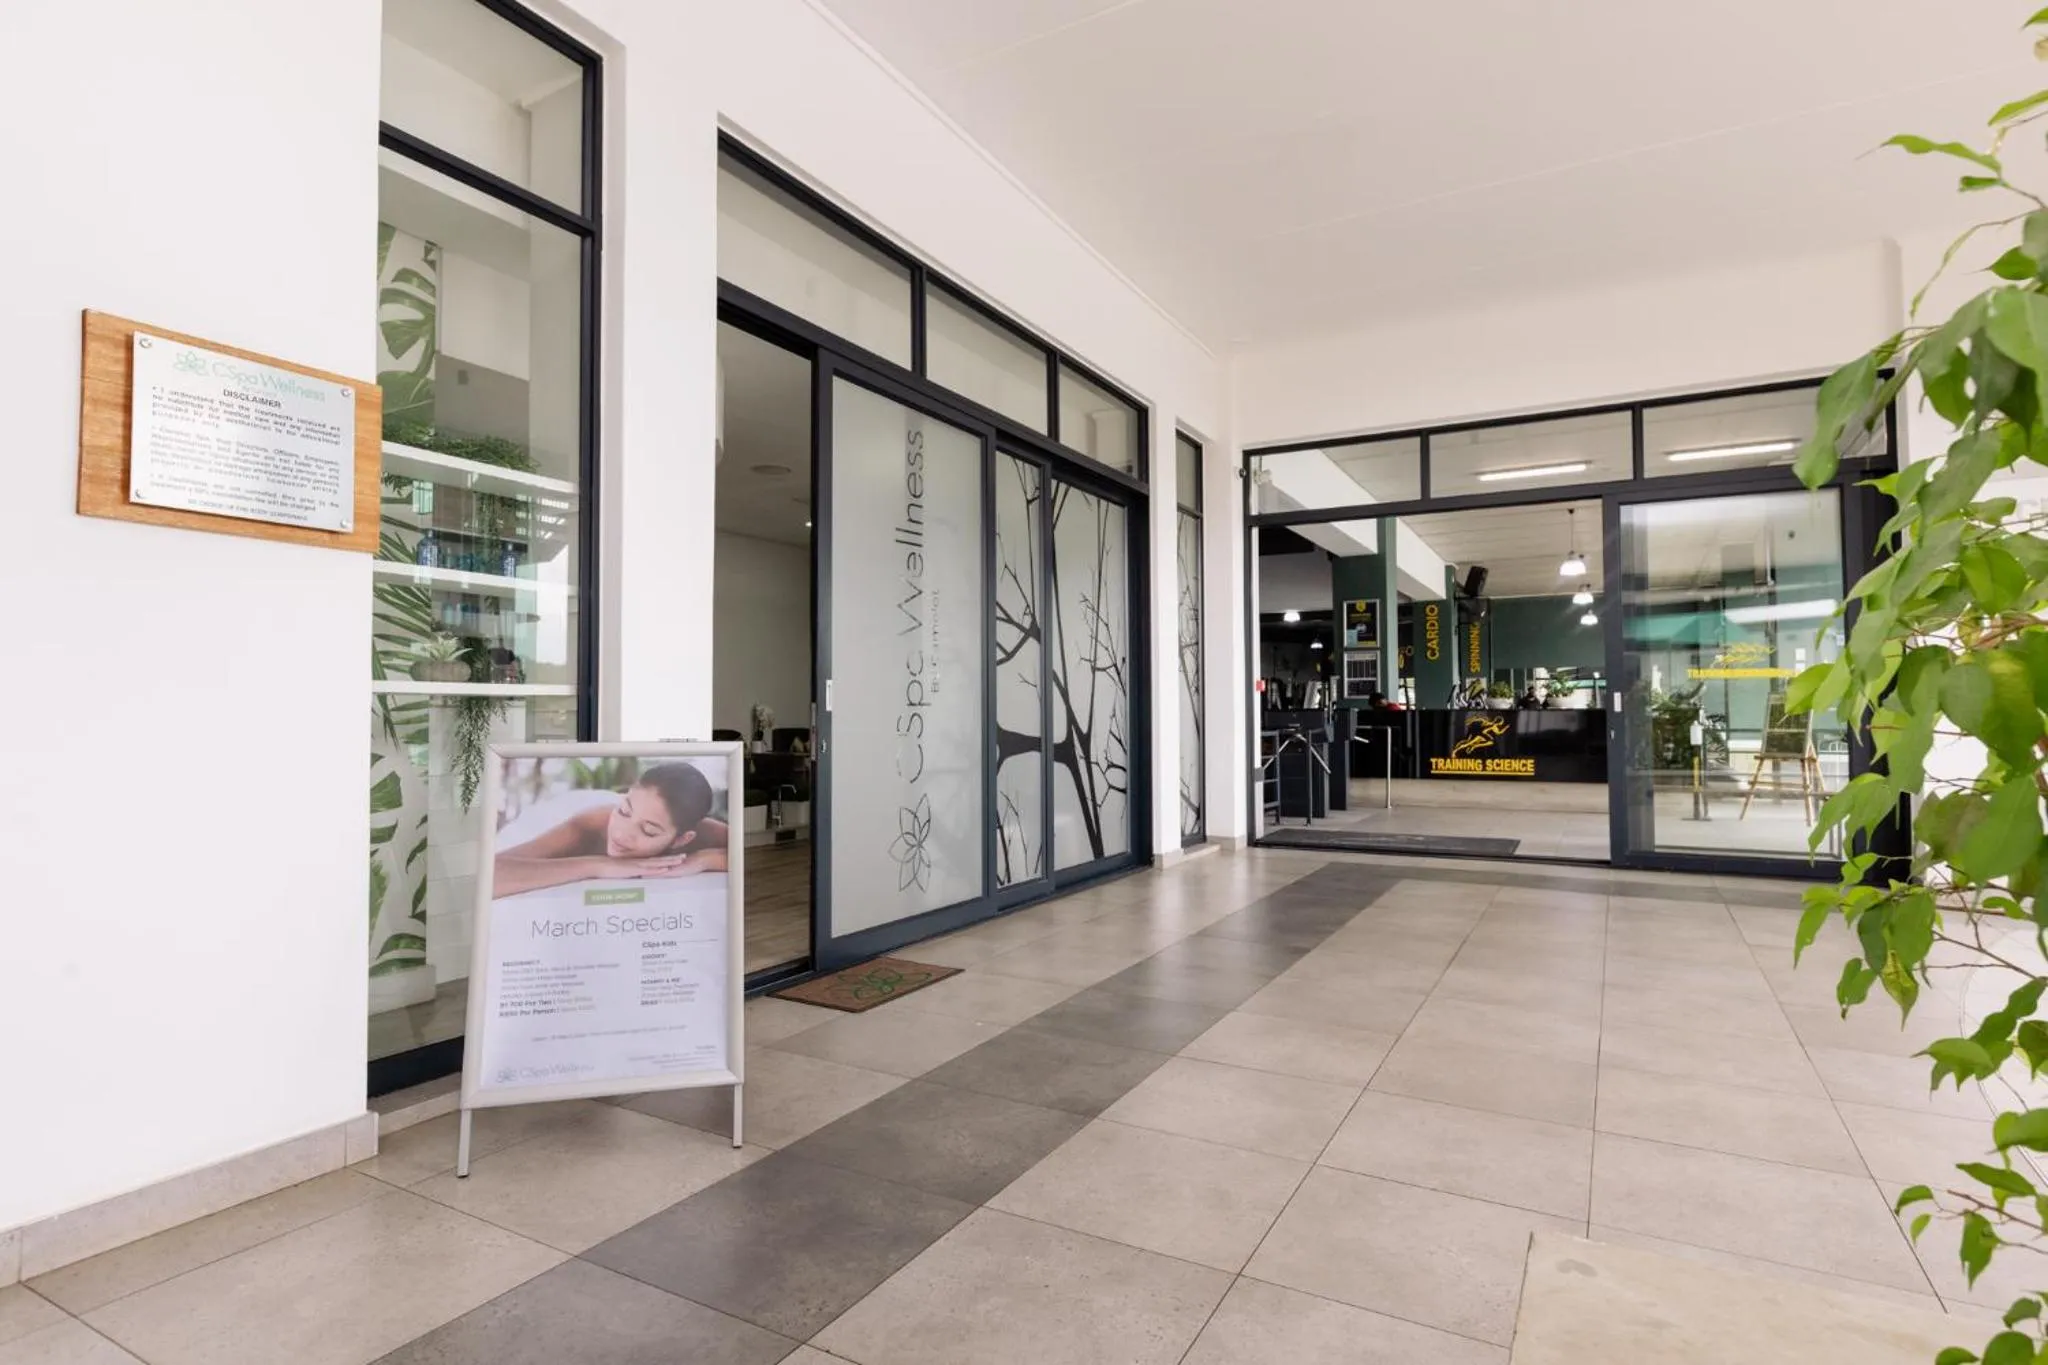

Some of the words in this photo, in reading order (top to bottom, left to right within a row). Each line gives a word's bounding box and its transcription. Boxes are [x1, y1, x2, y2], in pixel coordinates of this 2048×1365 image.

[212, 362, 258, 384] CSpa
[259, 372, 325, 402] Wellness
[223, 389, 281, 408] DISCLAIMER
[895, 429, 924, 636] Wellness
[1425, 604, 1440, 660] CARDIO
[1430, 758, 1483, 772] TRAINING
[1485, 759, 1535, 771] SCIENCE
[531, 917, 598, 938] March
[606, 912, 694, 935] Specials
